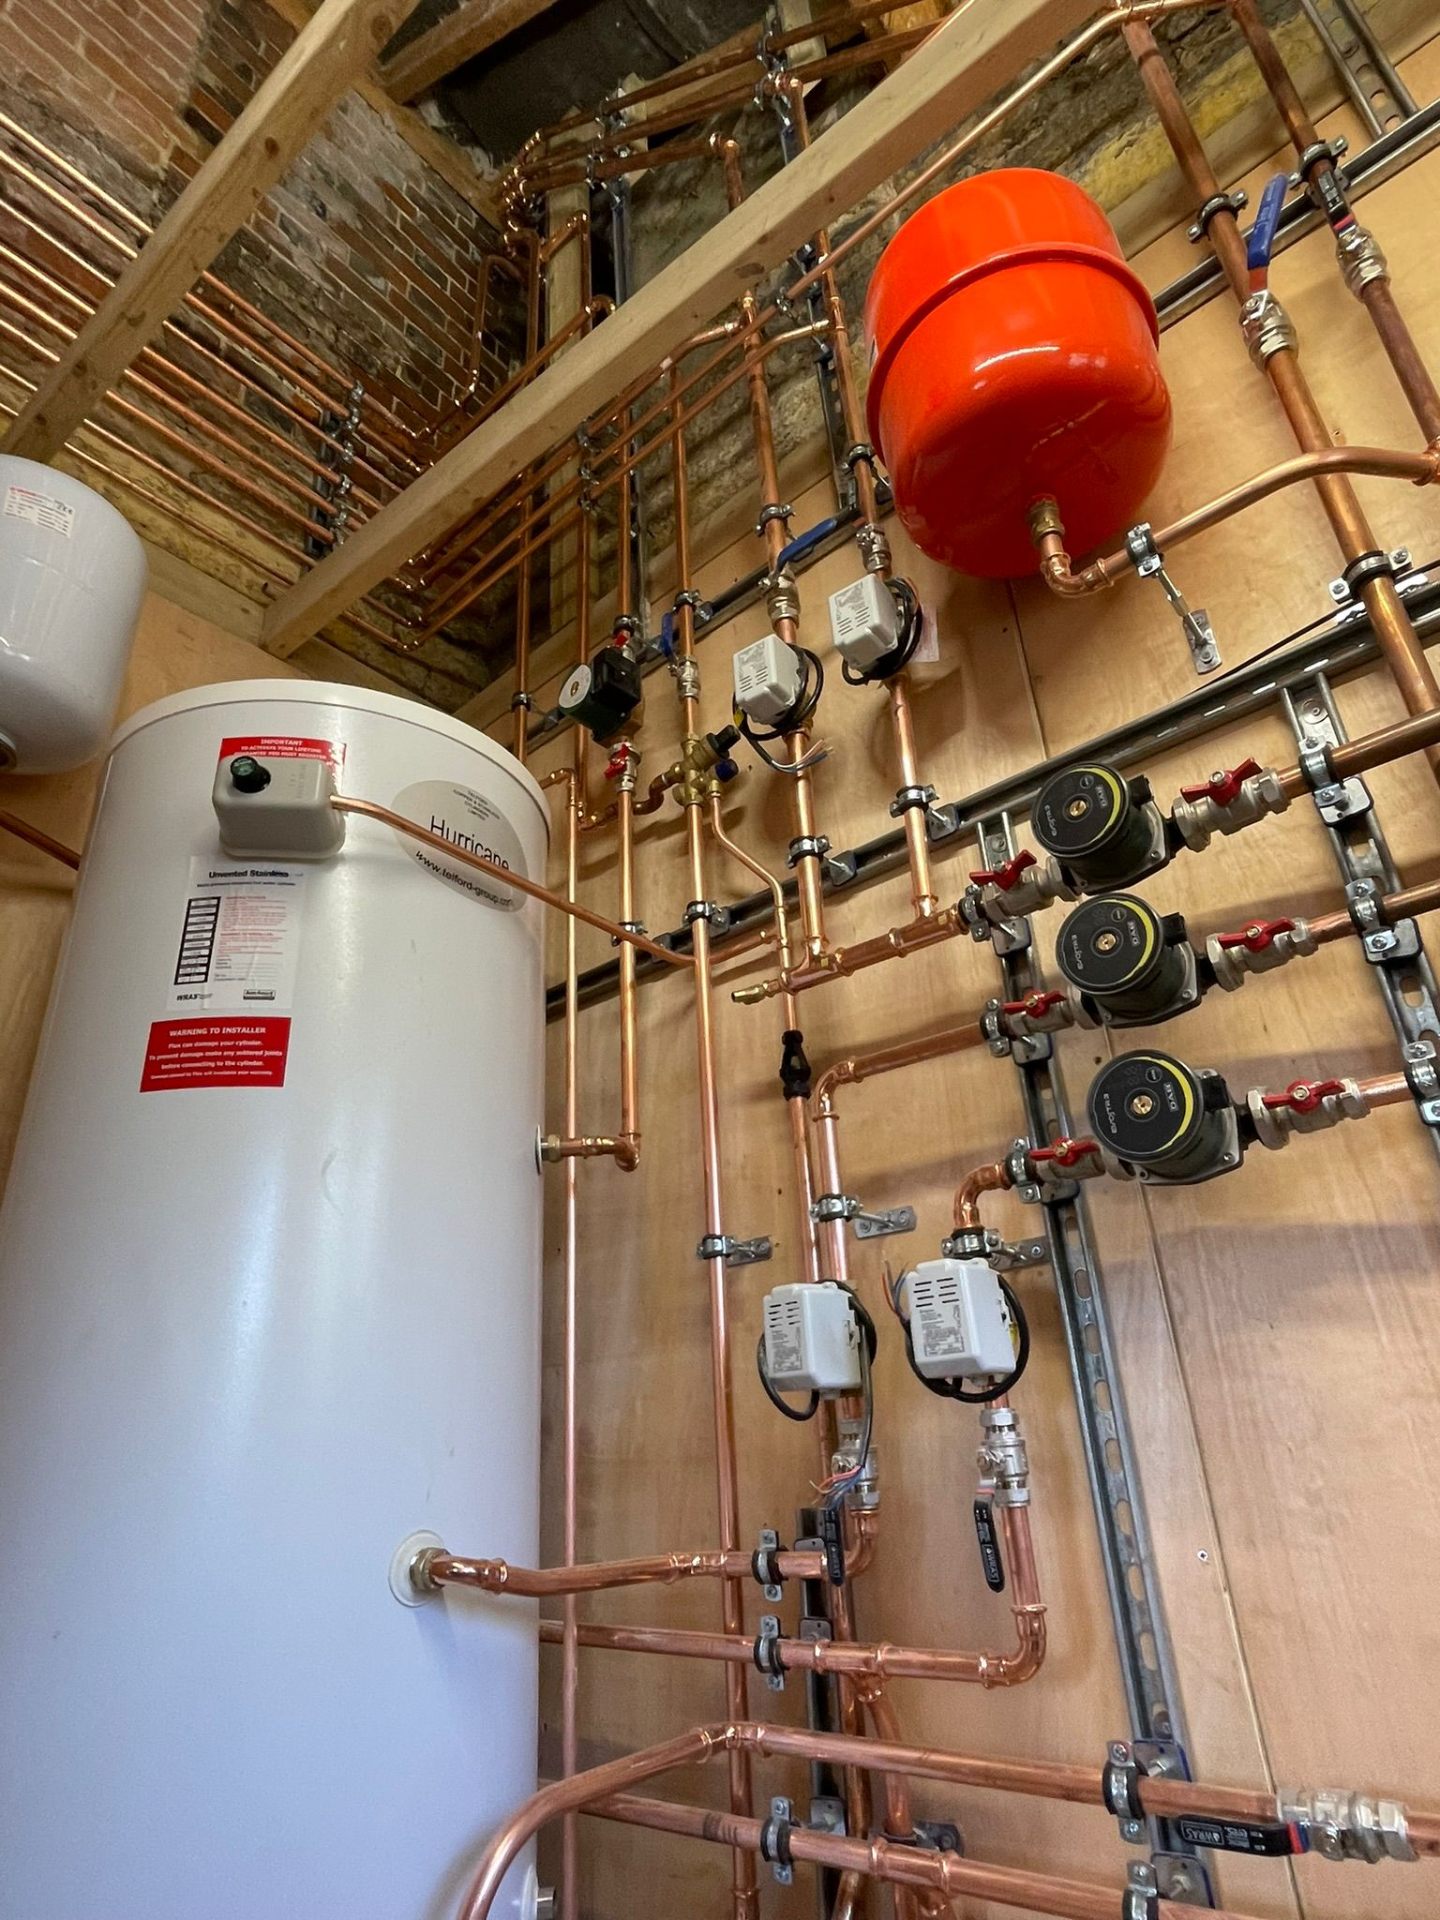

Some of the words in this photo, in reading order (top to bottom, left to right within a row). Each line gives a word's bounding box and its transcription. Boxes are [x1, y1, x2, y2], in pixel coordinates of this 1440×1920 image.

[430, 815, 510, 871] Hurricane
[169, 1028, 208, 1036] WARNING
[1185, 1827, 1215, 1841] WRAS
